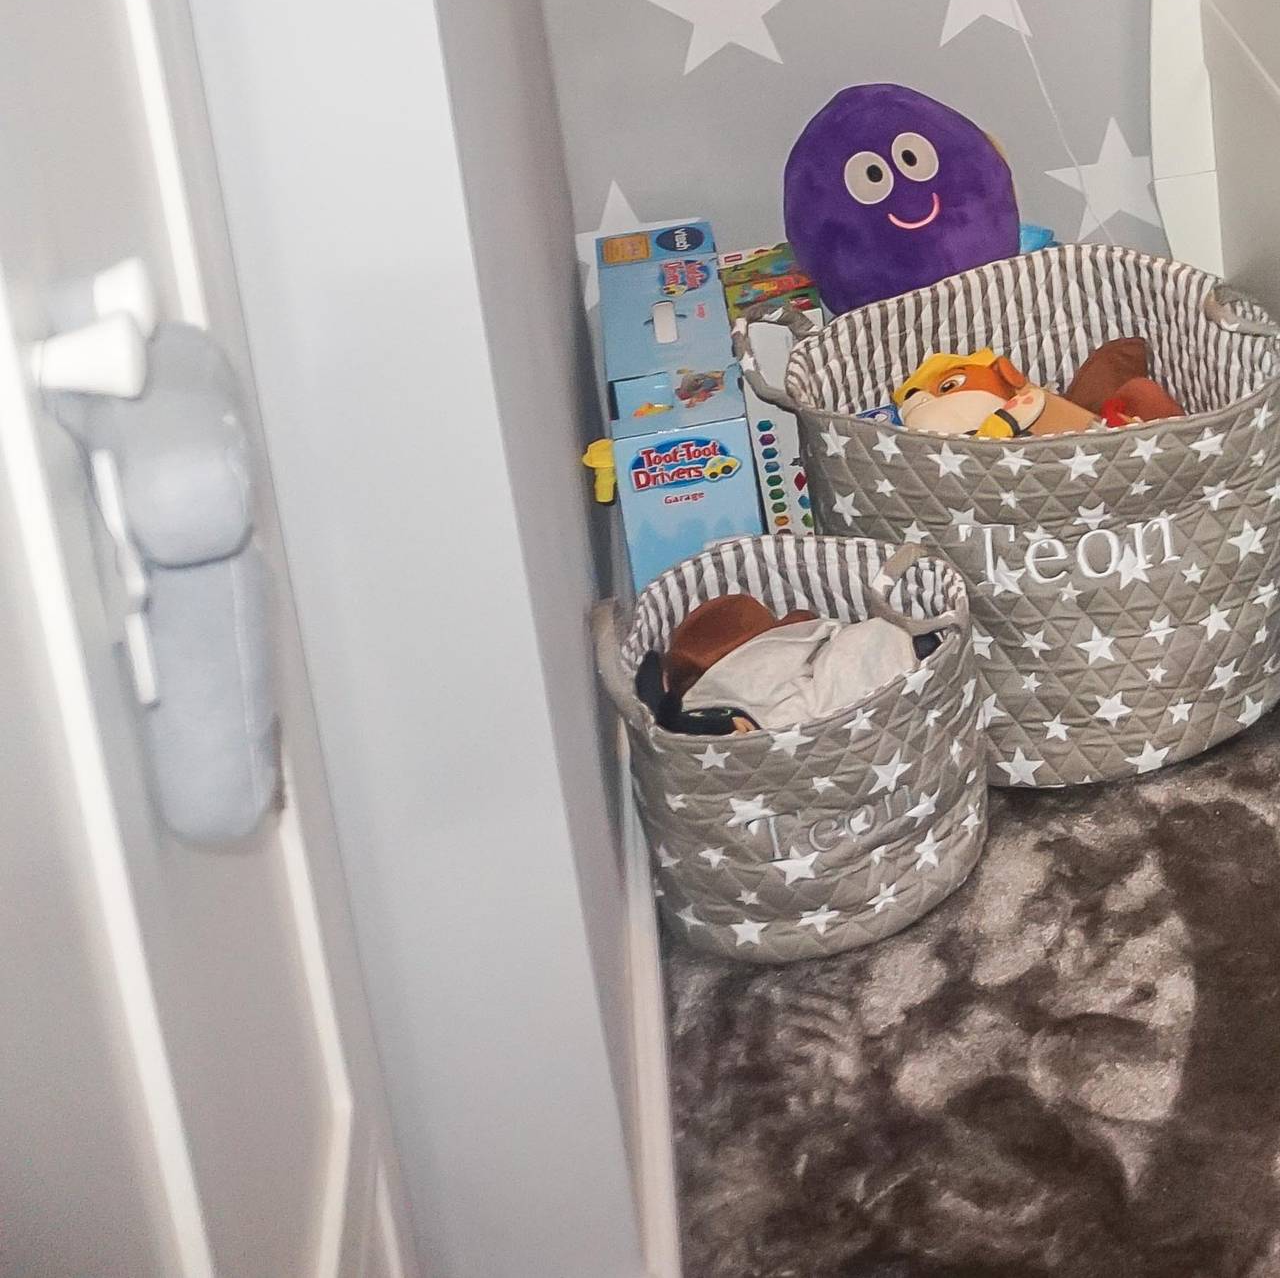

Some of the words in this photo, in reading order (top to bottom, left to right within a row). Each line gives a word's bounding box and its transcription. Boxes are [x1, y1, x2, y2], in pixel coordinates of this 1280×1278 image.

[641, 441, 719, 468] Toot-Toot
[632, 465, 704, 491] Drivers
[664, 492, 705, 505] Garage
[957, 517, 1181, 588] Teon
